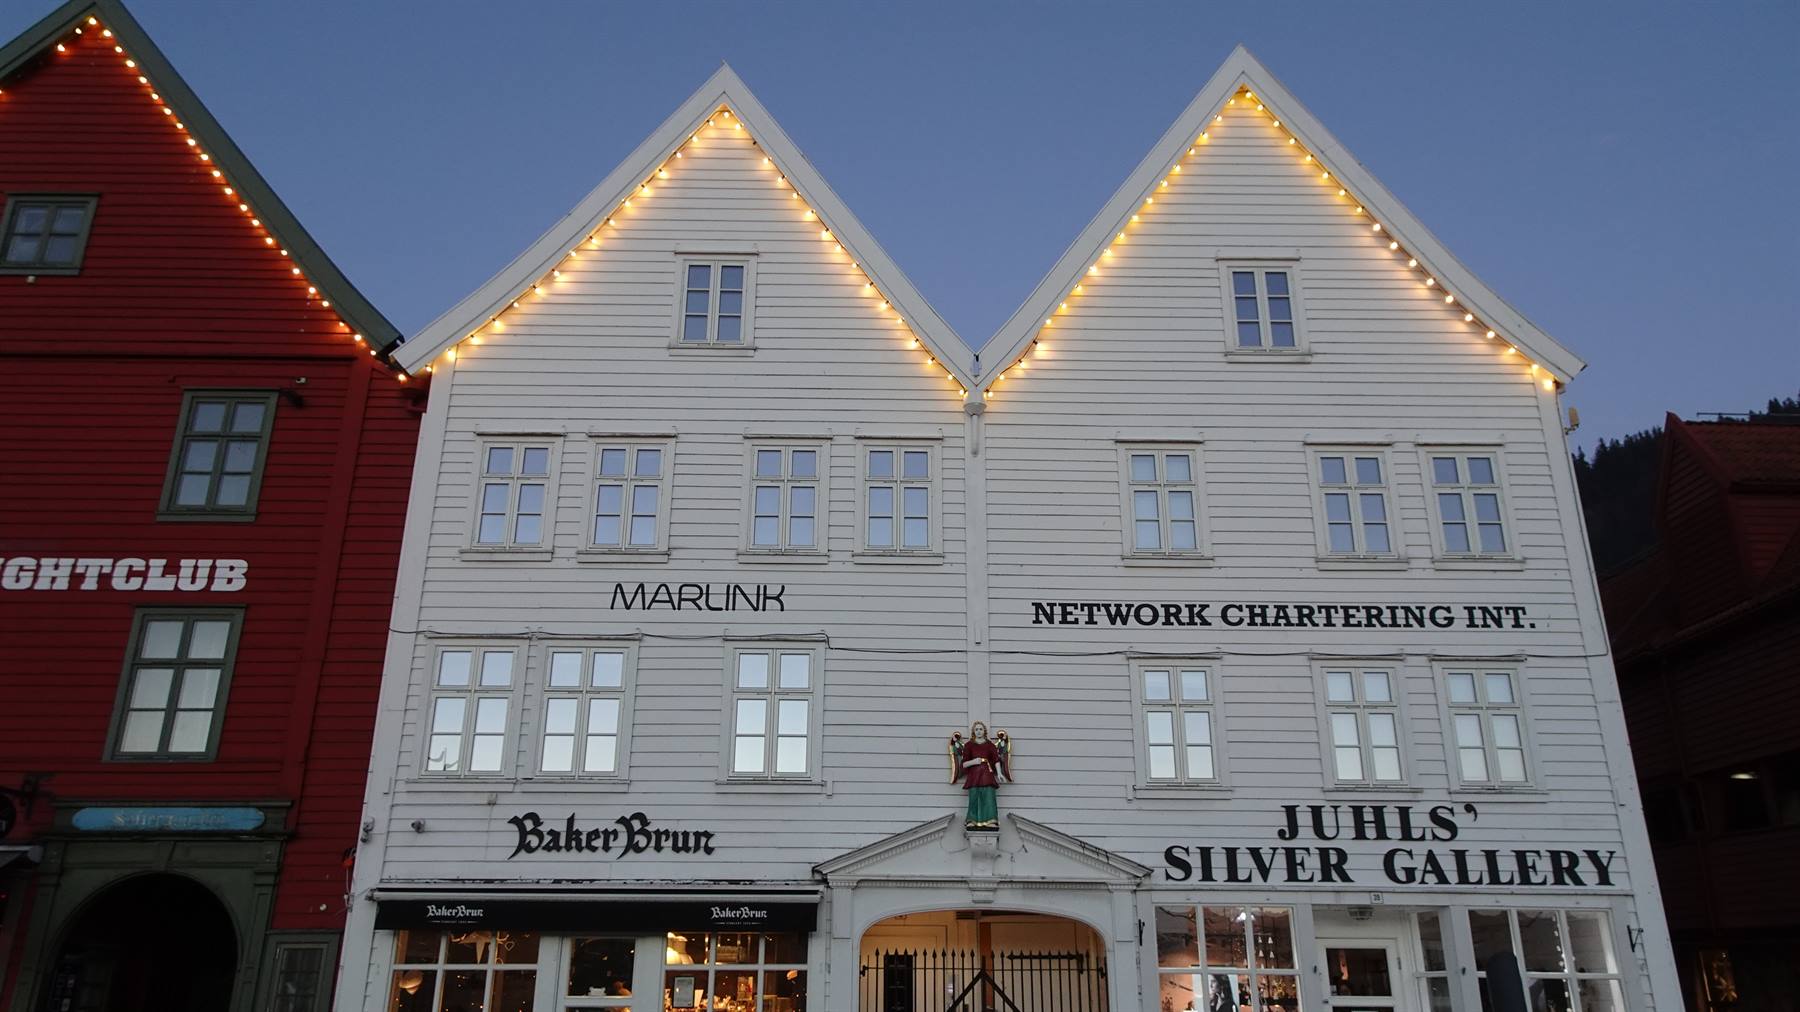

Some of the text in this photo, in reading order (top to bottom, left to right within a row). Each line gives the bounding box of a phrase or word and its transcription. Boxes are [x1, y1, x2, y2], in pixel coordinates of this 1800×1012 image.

[0, 557, 248, 592] GHTCLUB
[610, 582, 786, 612] MARLINK
[1031, 602, 1536, 630] NETWORK CHARTERING INT.
[507, 811, 716, 861] BakerBrun
[1277, 802, 1479, 842] JUHLS'
[1163, 845, 1617, 887] SILVER GALLERY
[426, 904, 484, 918] BakerBrun
[710, 906, 768, 919] BakerBrun
